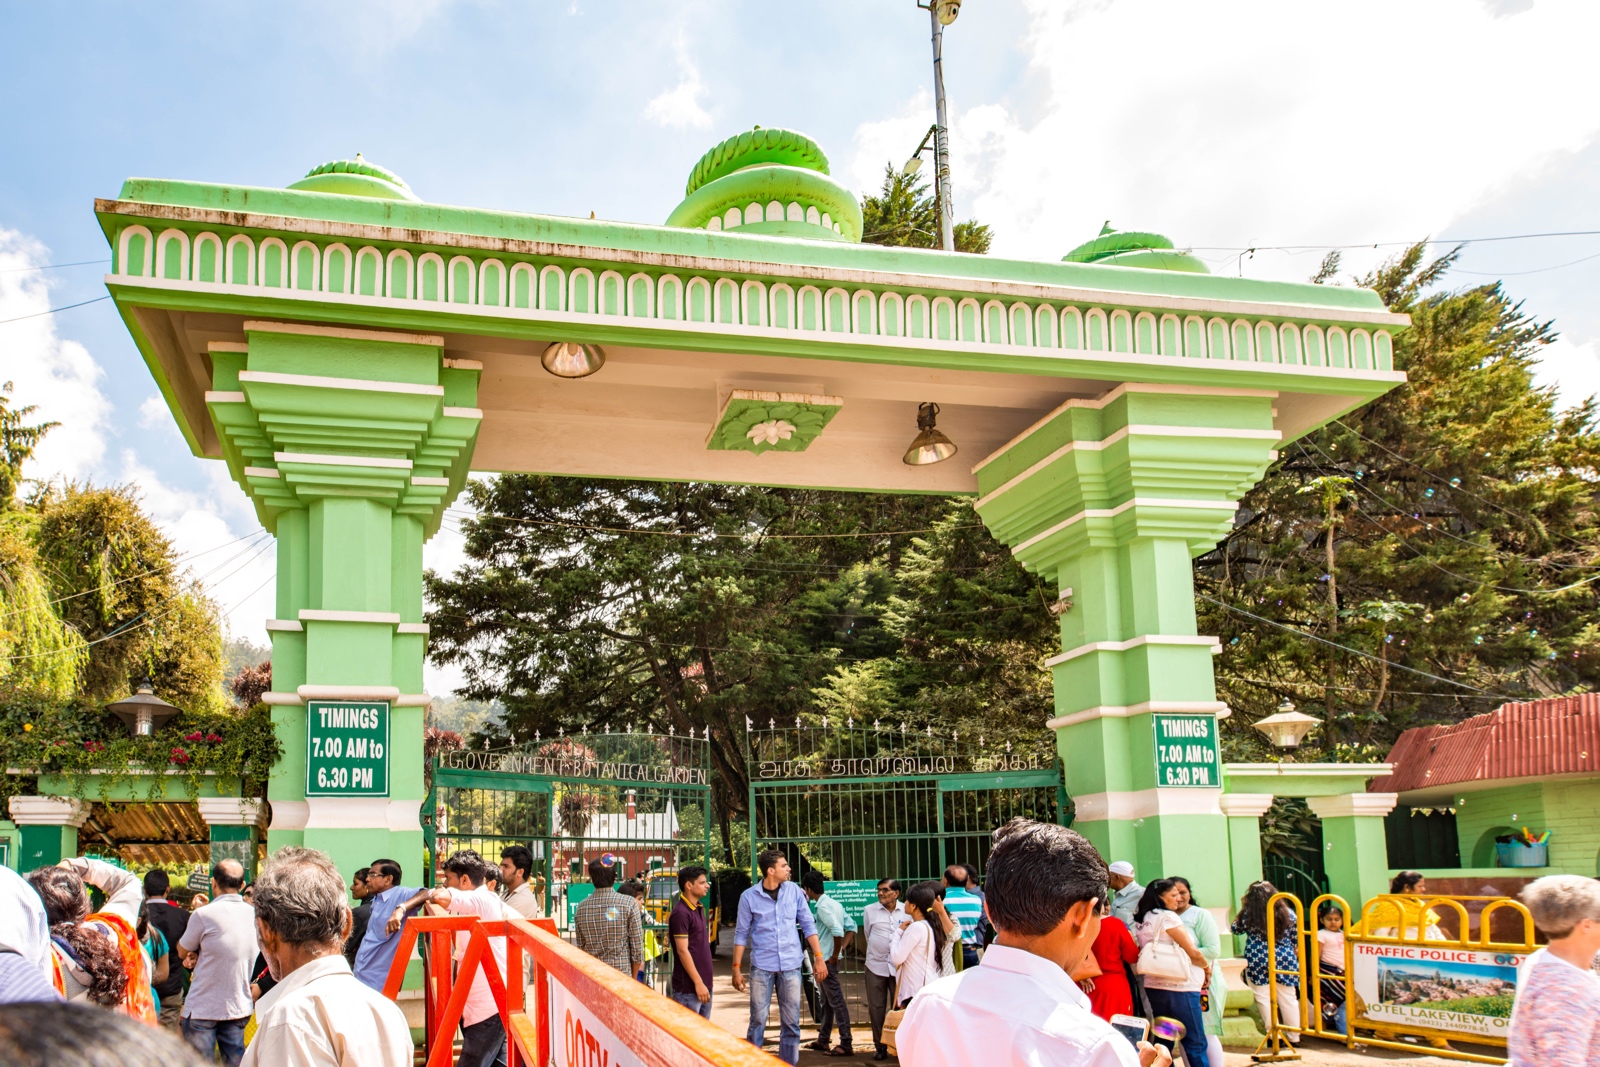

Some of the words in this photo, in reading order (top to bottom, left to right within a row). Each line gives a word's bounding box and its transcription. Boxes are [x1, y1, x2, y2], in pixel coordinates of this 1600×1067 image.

[318, 707, 379, 729] TIMINGS
[1161, 719, 1208, 738] TIMINGS
[312, 737, 343, 758] 7.00
[345, 737, 368, 759] AM
[369, 739, 384, 759] to
[1159, 745, 1183, 763] 7.00
[1185, 745, 1202, 763] AM
[1202, 745, 1214, 764] to
[449, 750, 566, 776] GOVERNMENT
[317, 767, 348, 788] 6.30
[352, 767, 373, 789] PM
[1166, 767, 1190, 785] 6.30
[1192, 767, 1209, 785] PM
[1357, 945, 1415, 959] TRAFFIC
[1420, 950, 1477, 963] POLICE
[1493, 955, 1526, 966] OO
[1366, 1003, 1406, 1016] HOTEL
[1410, 1008, 1488, 1027] LAKEVIEW,
